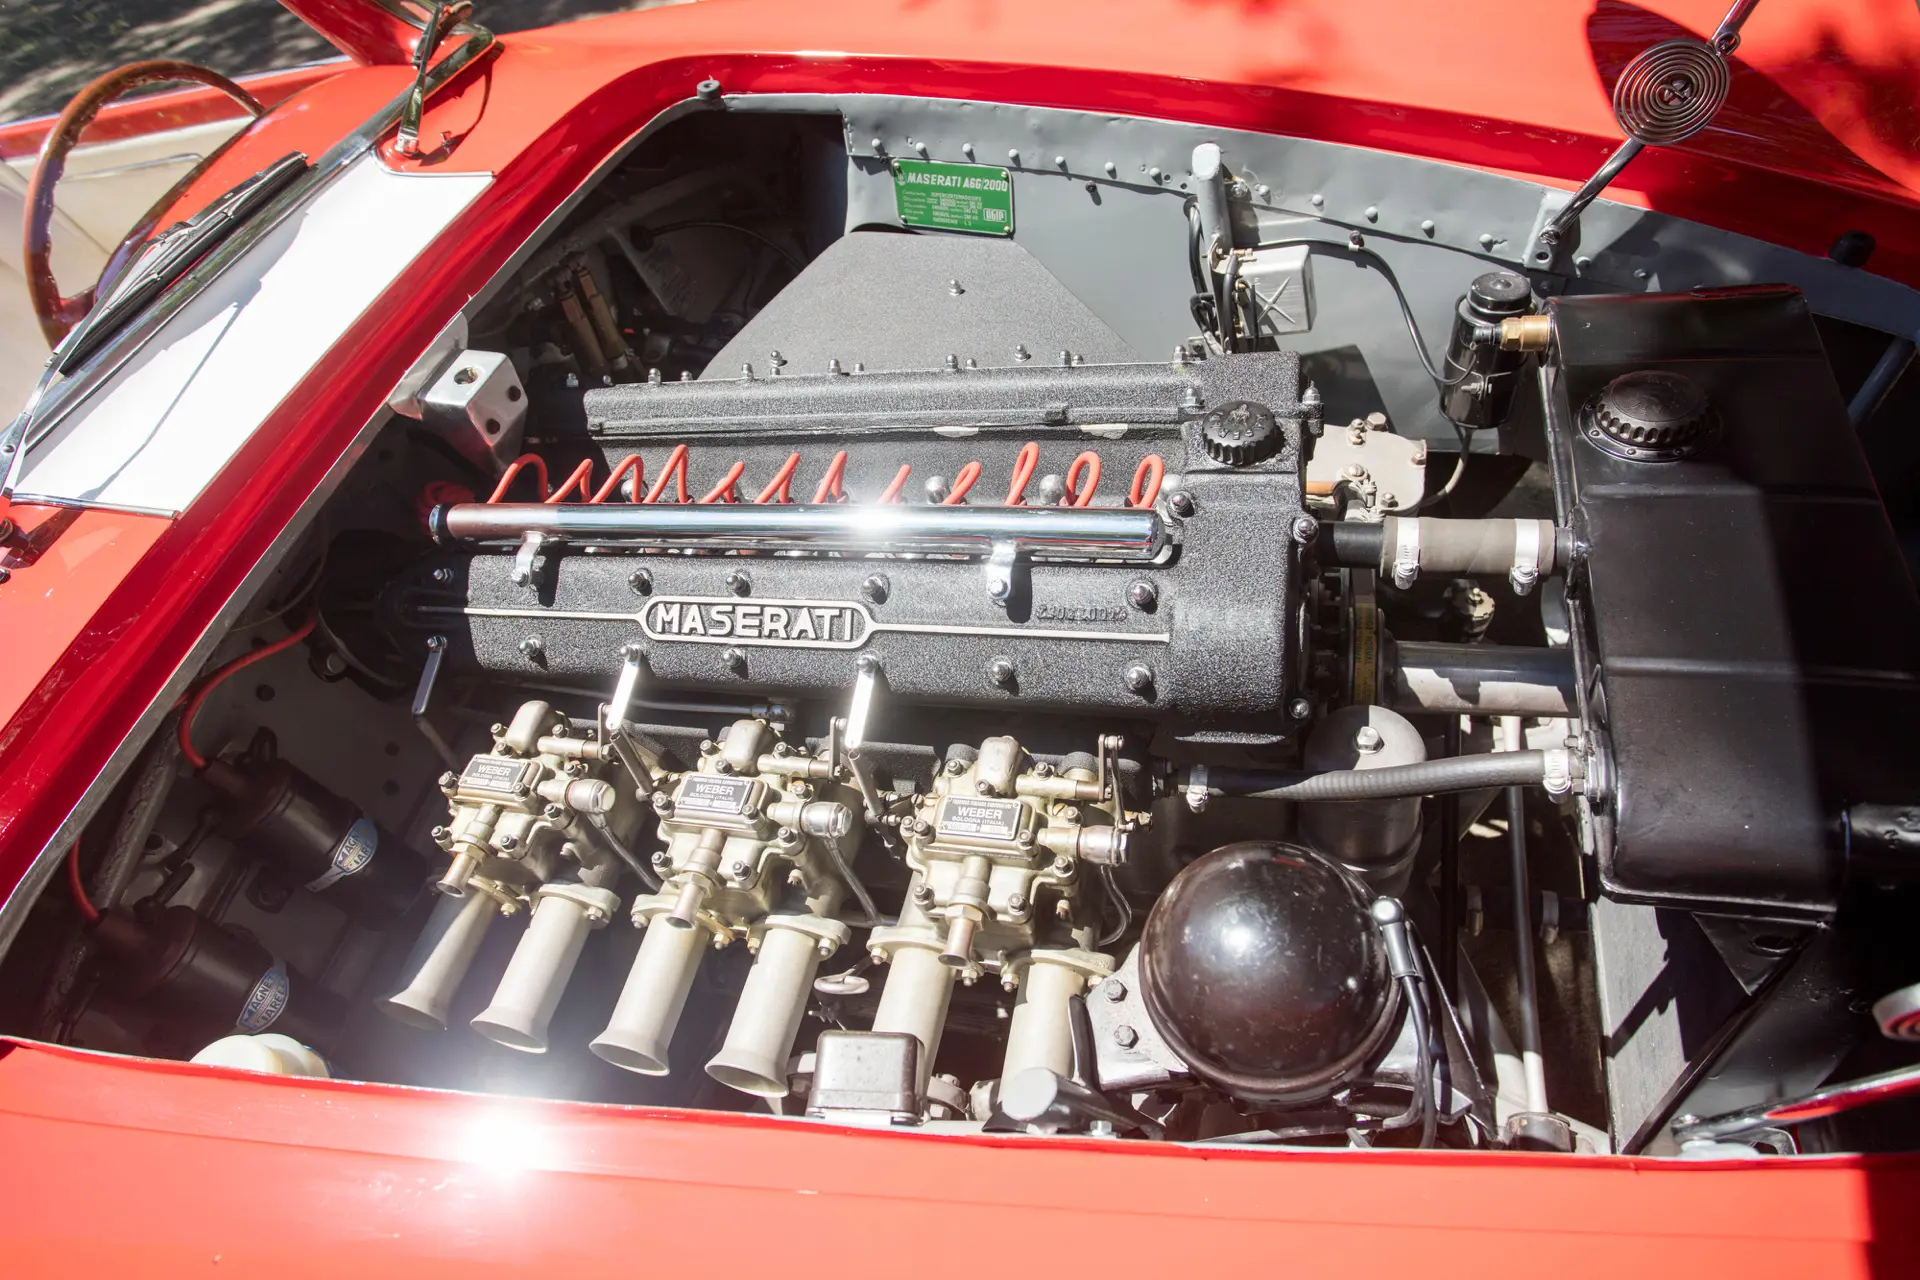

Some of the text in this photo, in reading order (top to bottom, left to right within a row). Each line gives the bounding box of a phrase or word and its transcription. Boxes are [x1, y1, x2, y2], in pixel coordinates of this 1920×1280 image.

[907, 172, 961, 187] MASERATI
[985, 209, 1006, 220] AGIP
[656, 603, 854, 641] MASERATI
[478, 764, 512, 776] WEBER
[696, 783, 734, 796] WEBER
[957, 806, 1003, 819] WEBER
[952, 816, 980, 824] BOLOGNA
